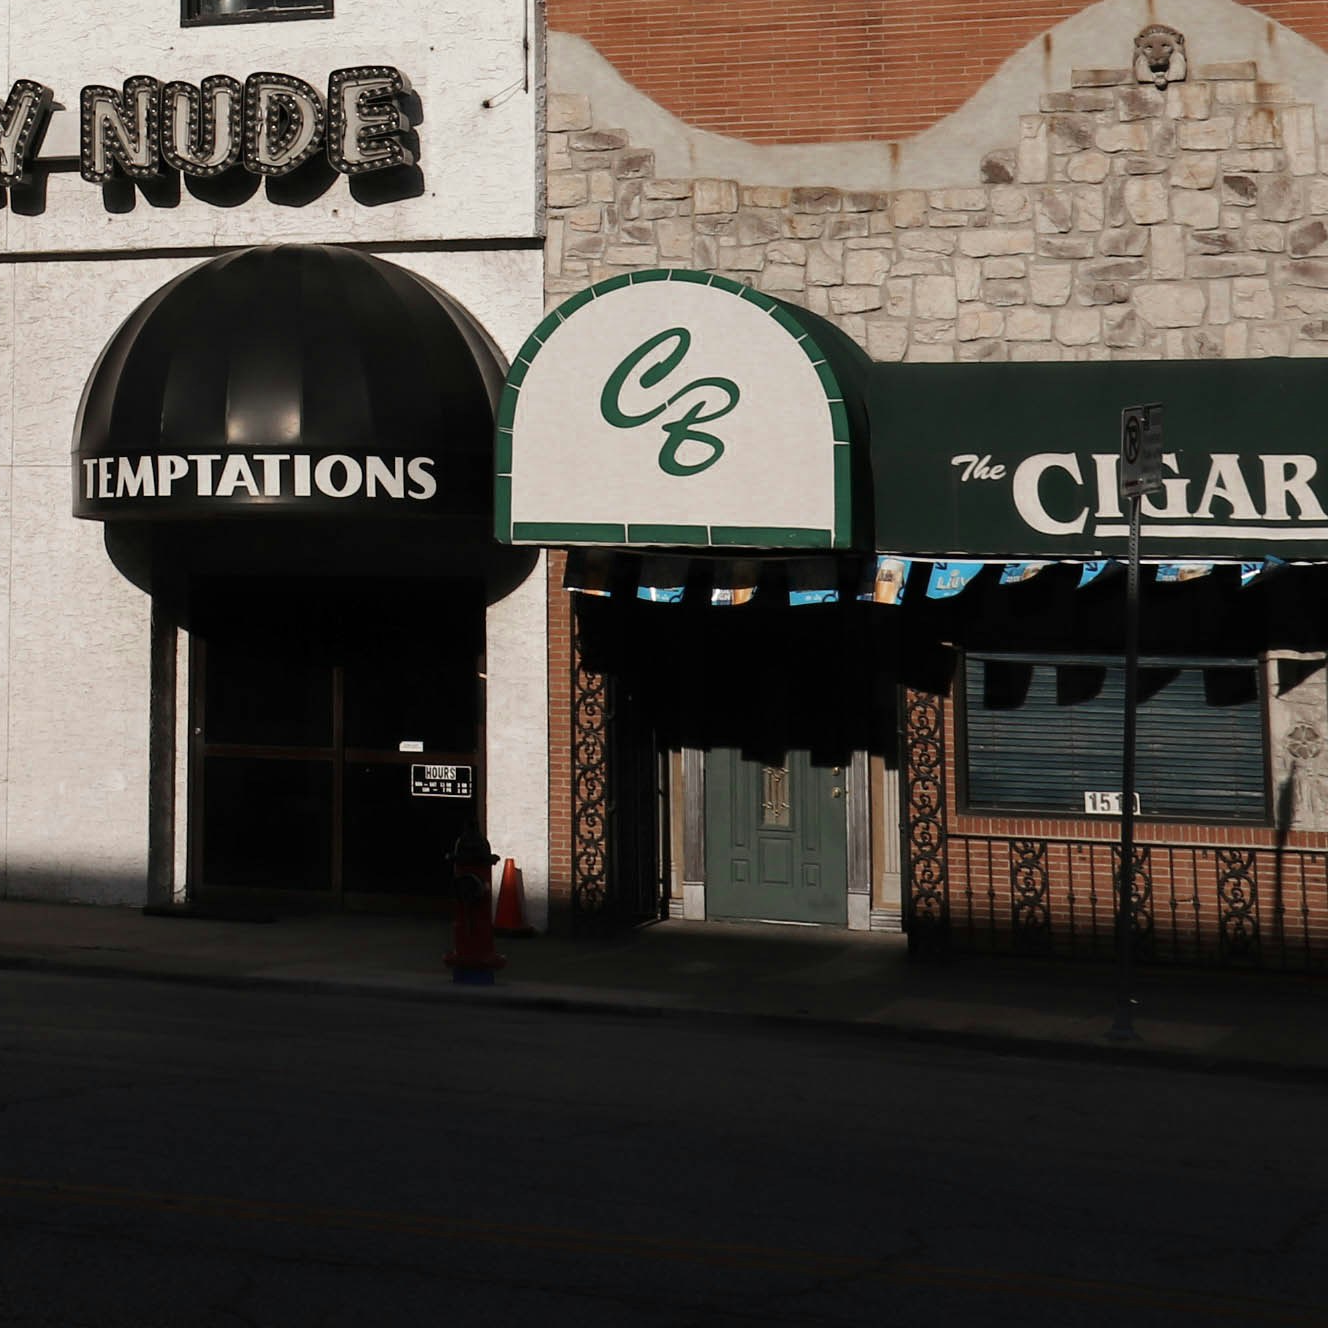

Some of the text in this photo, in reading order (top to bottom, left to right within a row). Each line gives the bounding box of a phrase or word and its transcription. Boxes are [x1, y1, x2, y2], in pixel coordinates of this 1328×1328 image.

[80, 65, 414, 184] NUDE
[600, 327, 741, 477] CB
[82, 453, 437, 500] TEMPTATIONS
[951, 454, 1007, 482] The
[1012, 452, 1328, 535] CIGAR
[425, 766, 456, 779] HOURS
